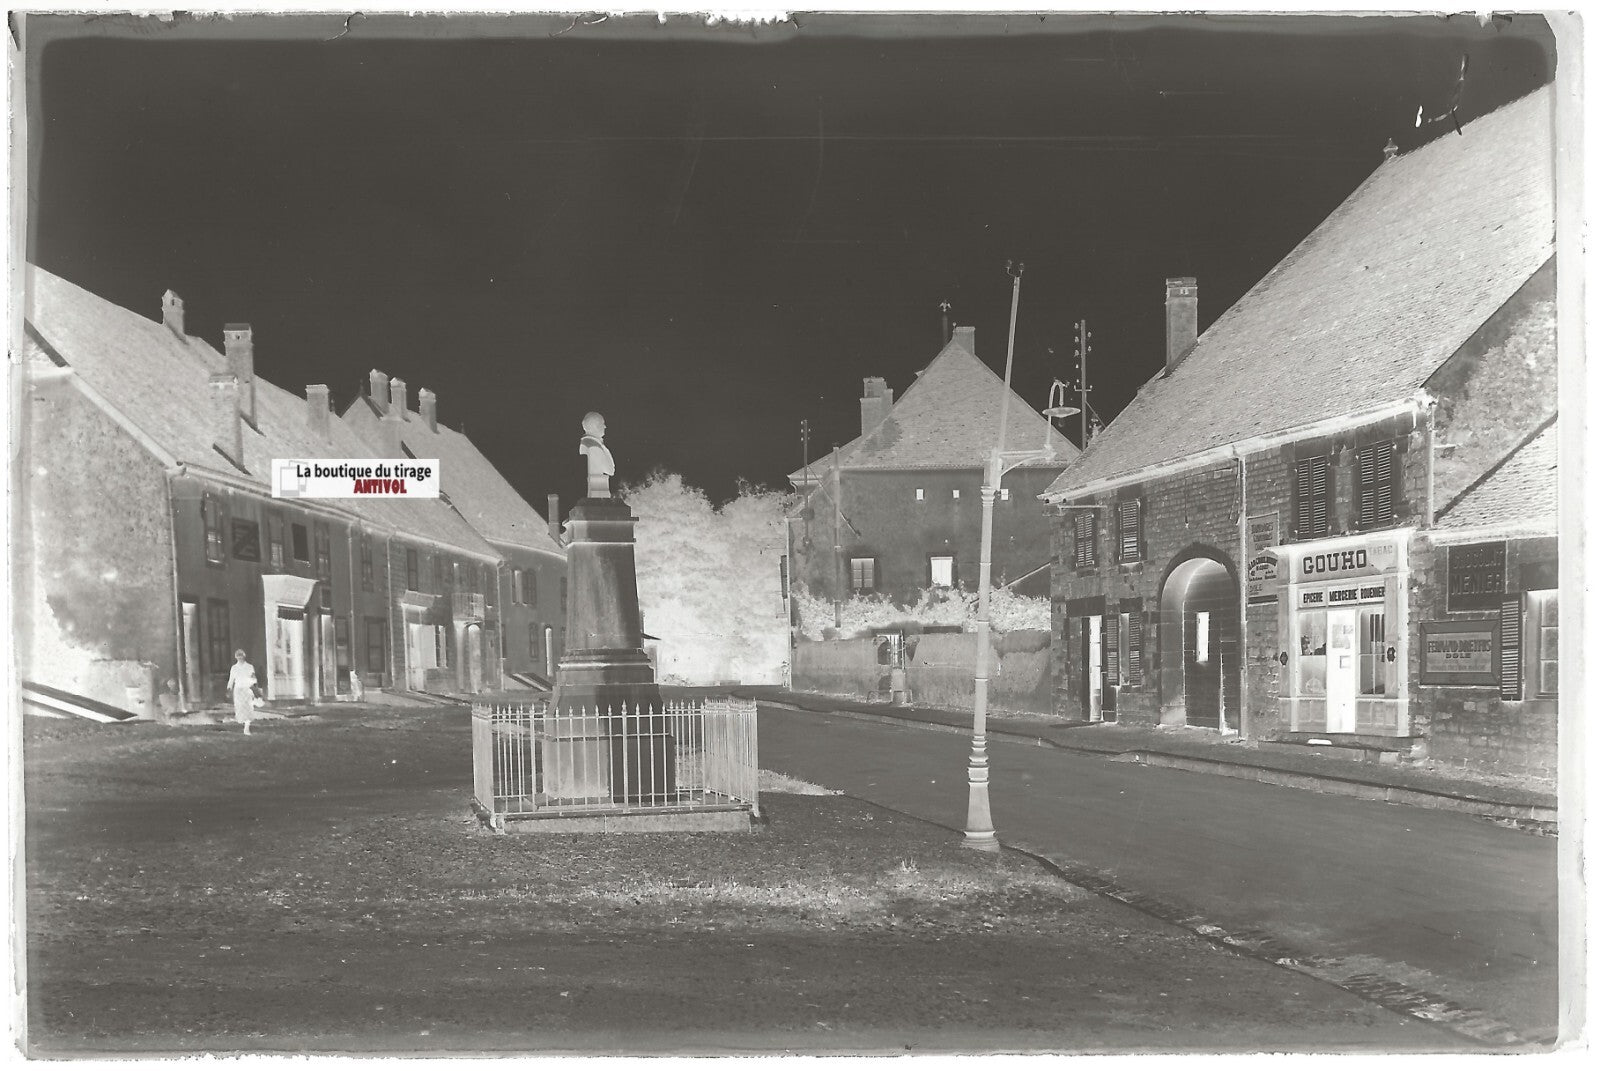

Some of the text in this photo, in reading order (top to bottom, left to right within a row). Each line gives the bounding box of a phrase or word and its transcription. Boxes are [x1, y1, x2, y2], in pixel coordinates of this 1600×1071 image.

[1303, 549, 1367, 574] GOUHO
[1450, 573, 1504, 596] MENIER
[1303, 591, 1324, 604] EPICERIE
[1329, 588, 1358, 602] MERCERIE
